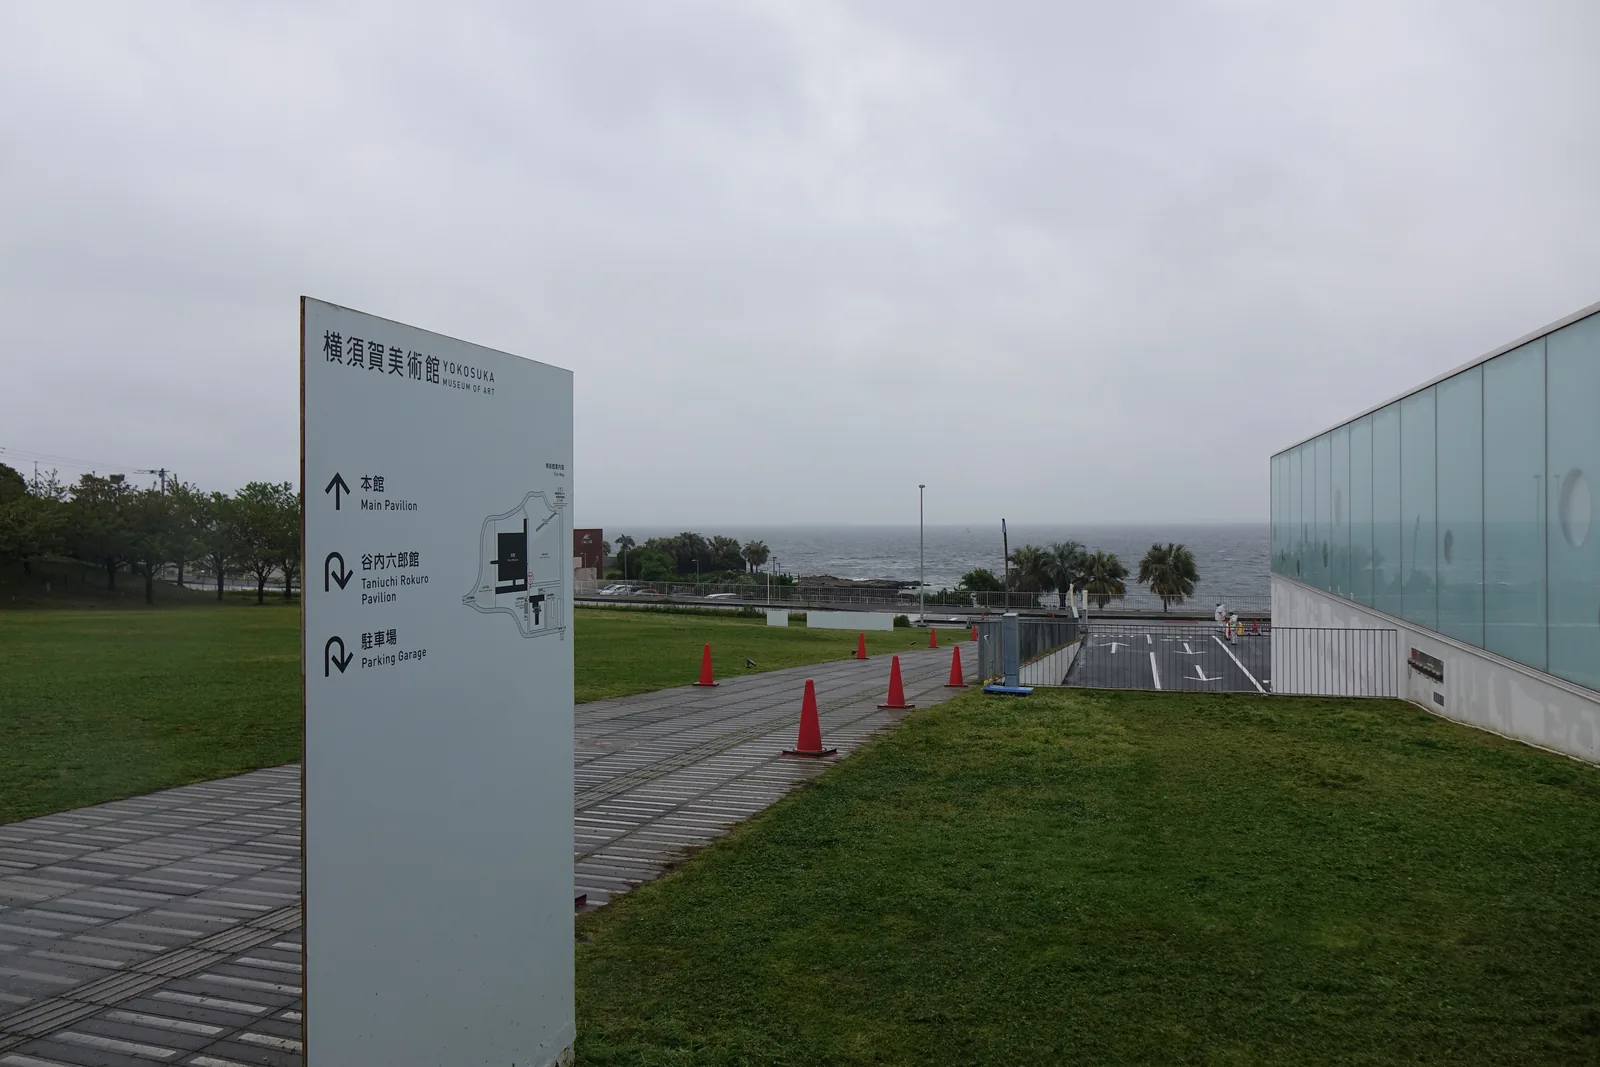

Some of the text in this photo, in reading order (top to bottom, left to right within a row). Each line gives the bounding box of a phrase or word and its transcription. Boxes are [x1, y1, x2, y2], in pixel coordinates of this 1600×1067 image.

[323, 330, 440, 385] 横須賀美術館
[443, 360, 495, 383] YOKOSUKA
[442, 378, 495, 396] MUSEUM OF ART
[360, 474, 385, 492] 本館
[361, 499, 418, 511] Main Pavilion
[361, 551, 420, 571] 谷内六郎館
[361, 574, 429, 589] Taniuchi Rokuro
[361, 591, 397, 605] Pavilion
[361, 628, 397, 651] 駐車場
[361, 648, 427, 669] Parking Garage
